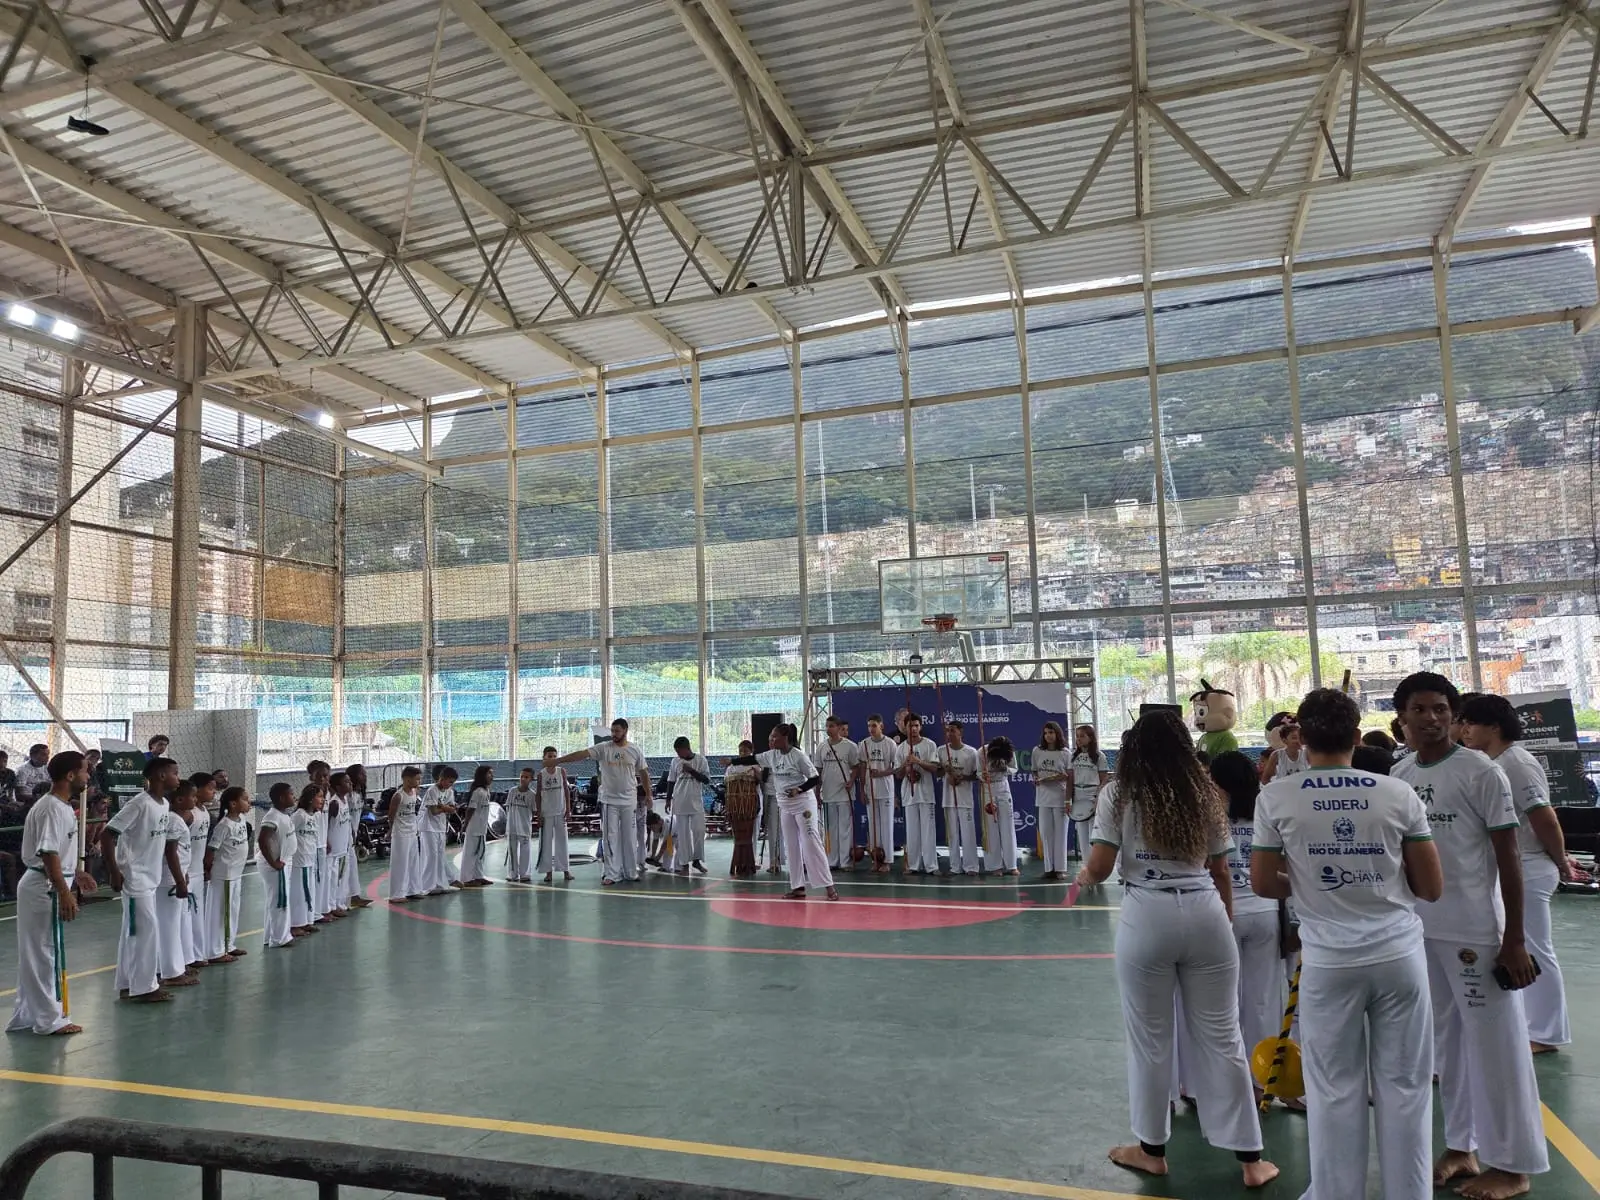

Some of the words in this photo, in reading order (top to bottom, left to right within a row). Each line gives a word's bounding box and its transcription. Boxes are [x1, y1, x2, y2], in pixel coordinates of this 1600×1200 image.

[1301, 776, 1377, 789] ALUNO
[1312, 799, 1370, 811] SUDERJ
[1309, 847, 1326, 856] RIO
[1328, 847, 1341, 855] DE
[1343, 847, 1385, 855] JANEIRO
[1341, 870, 1384, 884] CHAYA
